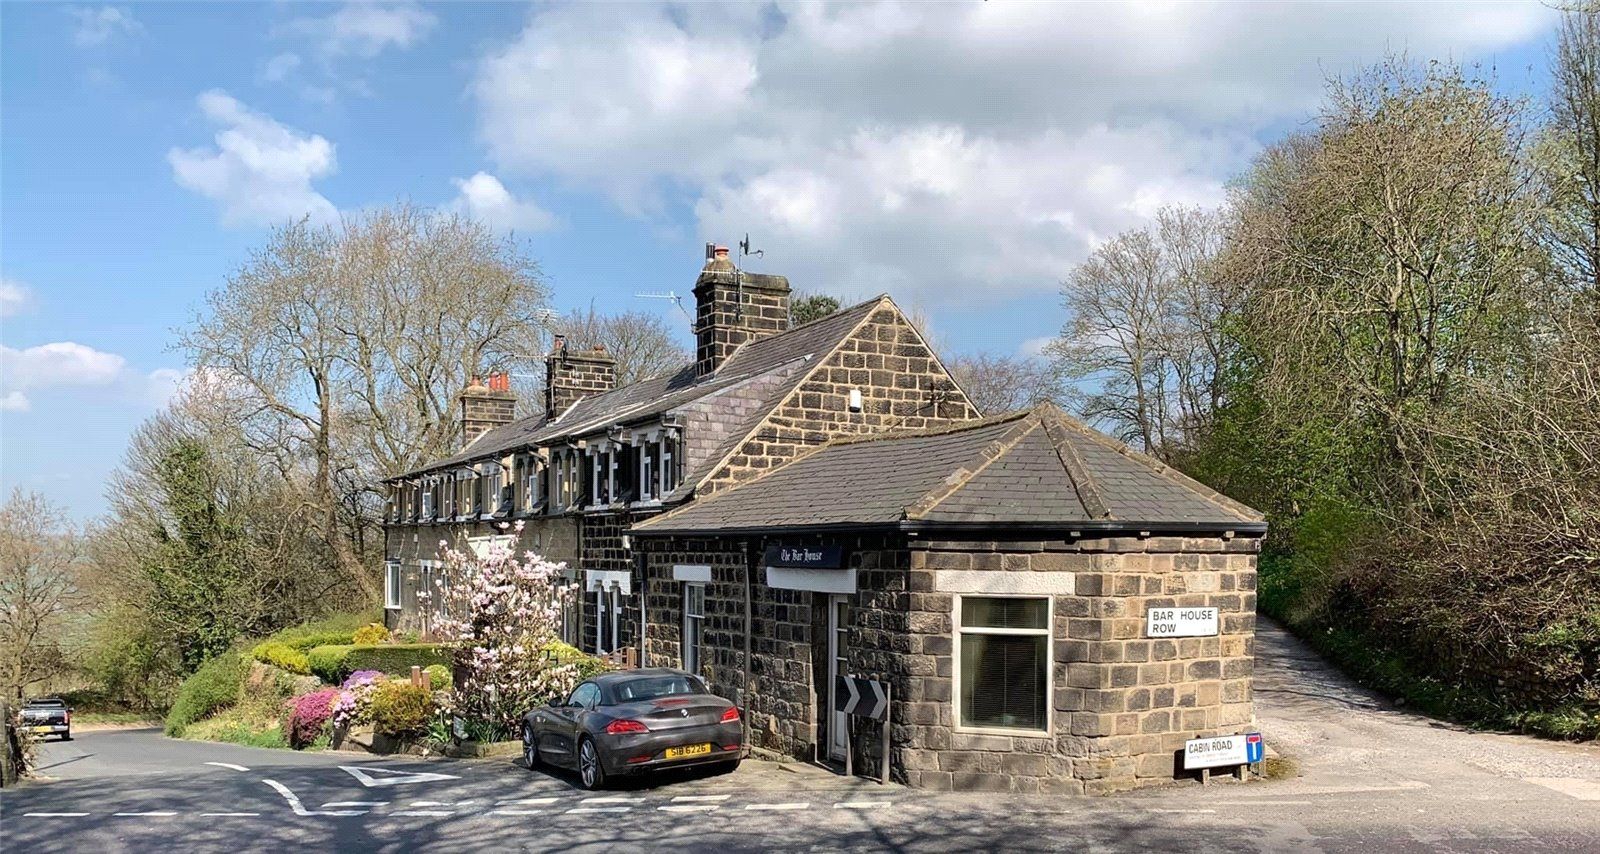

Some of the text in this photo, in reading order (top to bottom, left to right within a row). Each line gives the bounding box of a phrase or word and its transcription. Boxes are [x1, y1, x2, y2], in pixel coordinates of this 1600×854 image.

[792, 549, 803, 561] Bar
[803, 548, 822, 563] House
[1153, 610, 1213, 620] BAR HOUSE
[1152, 624, 1176, 633] ROW
[686, 745, 706, 754] 6226
[1189, 740, 1232, 754] CABIN ROAD
